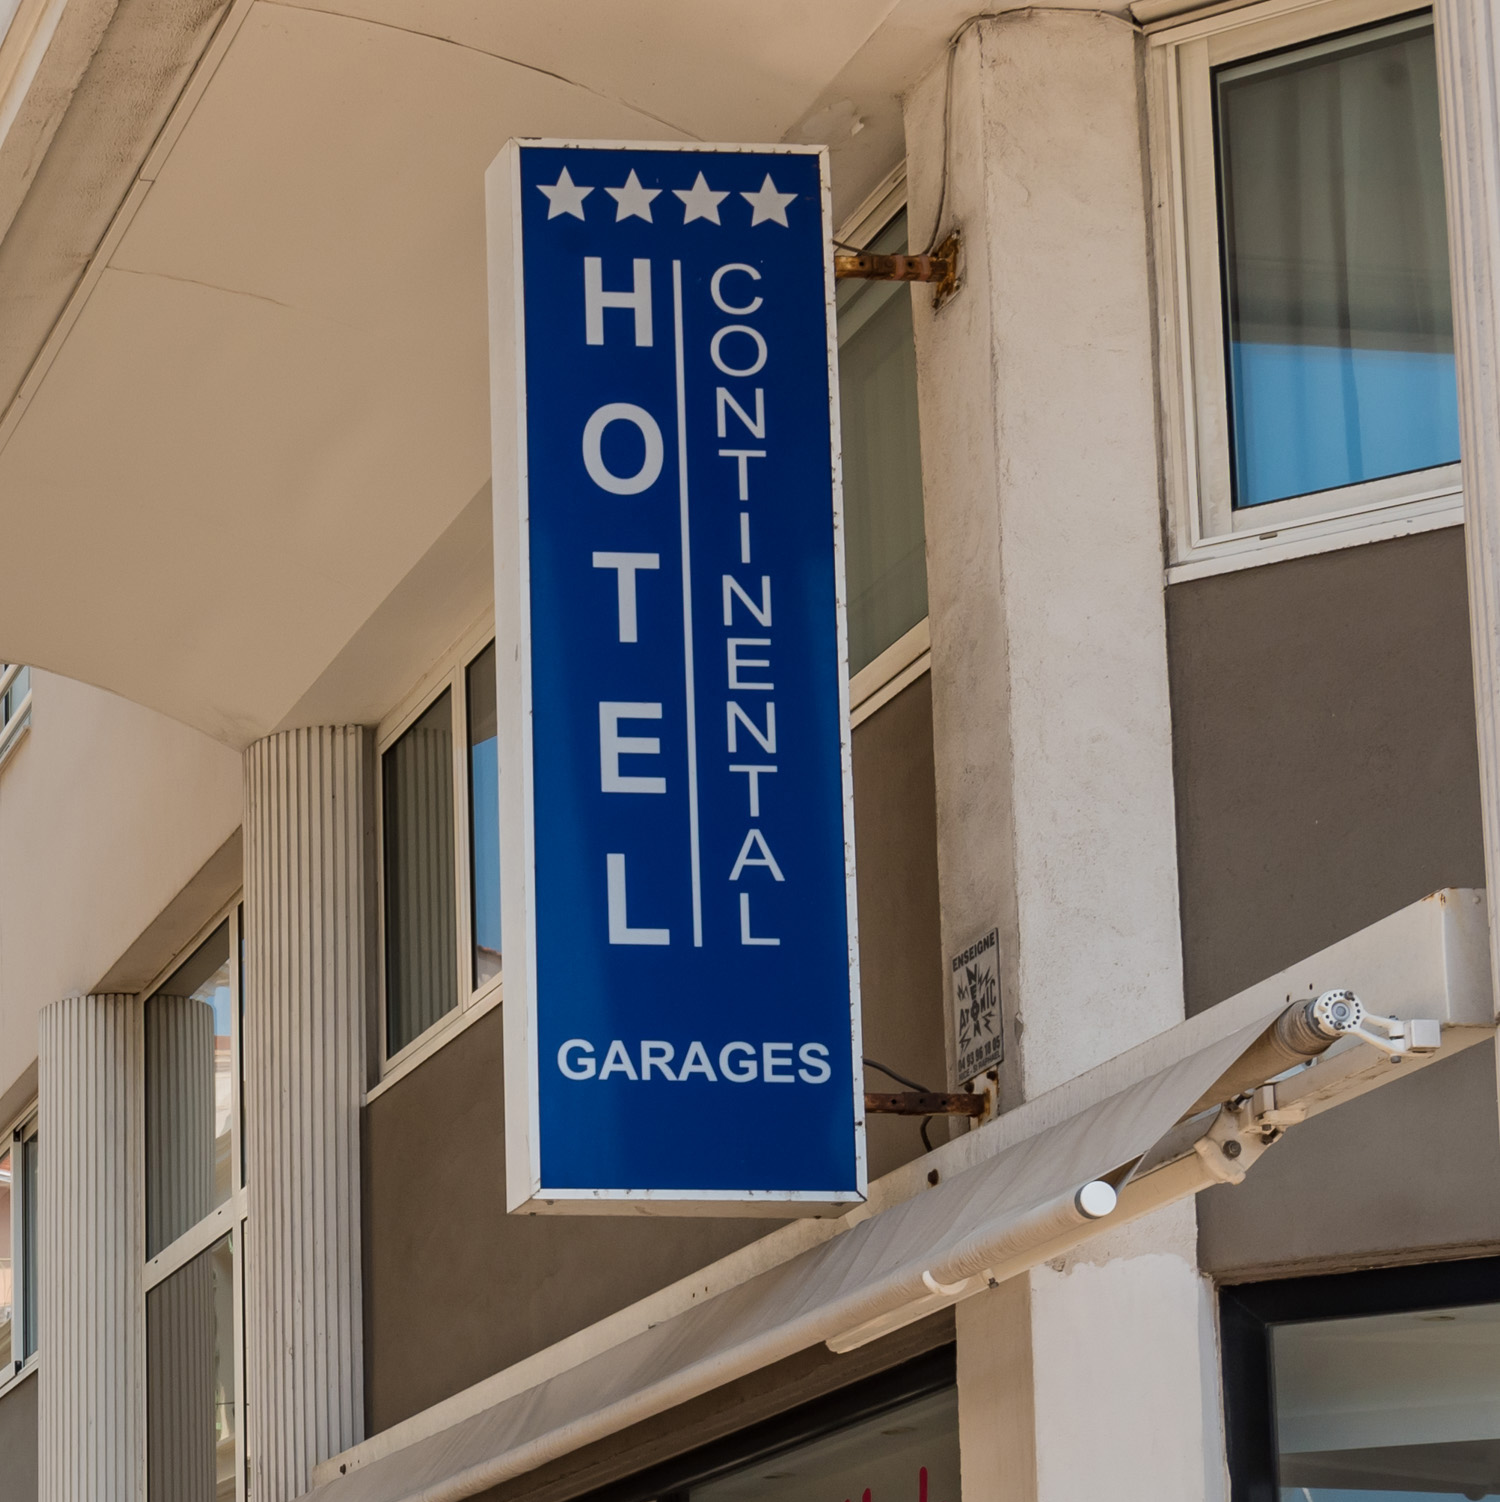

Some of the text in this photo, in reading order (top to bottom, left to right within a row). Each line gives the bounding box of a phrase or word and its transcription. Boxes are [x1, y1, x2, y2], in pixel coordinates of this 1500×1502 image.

[582, 257, 670, 945] HOTEL
[710, 263, 785, 946] CONTINENTAL
[557, 1038, 831, 1084] GARAGES
[953, 932, 995, 972] ENSEIGNE
